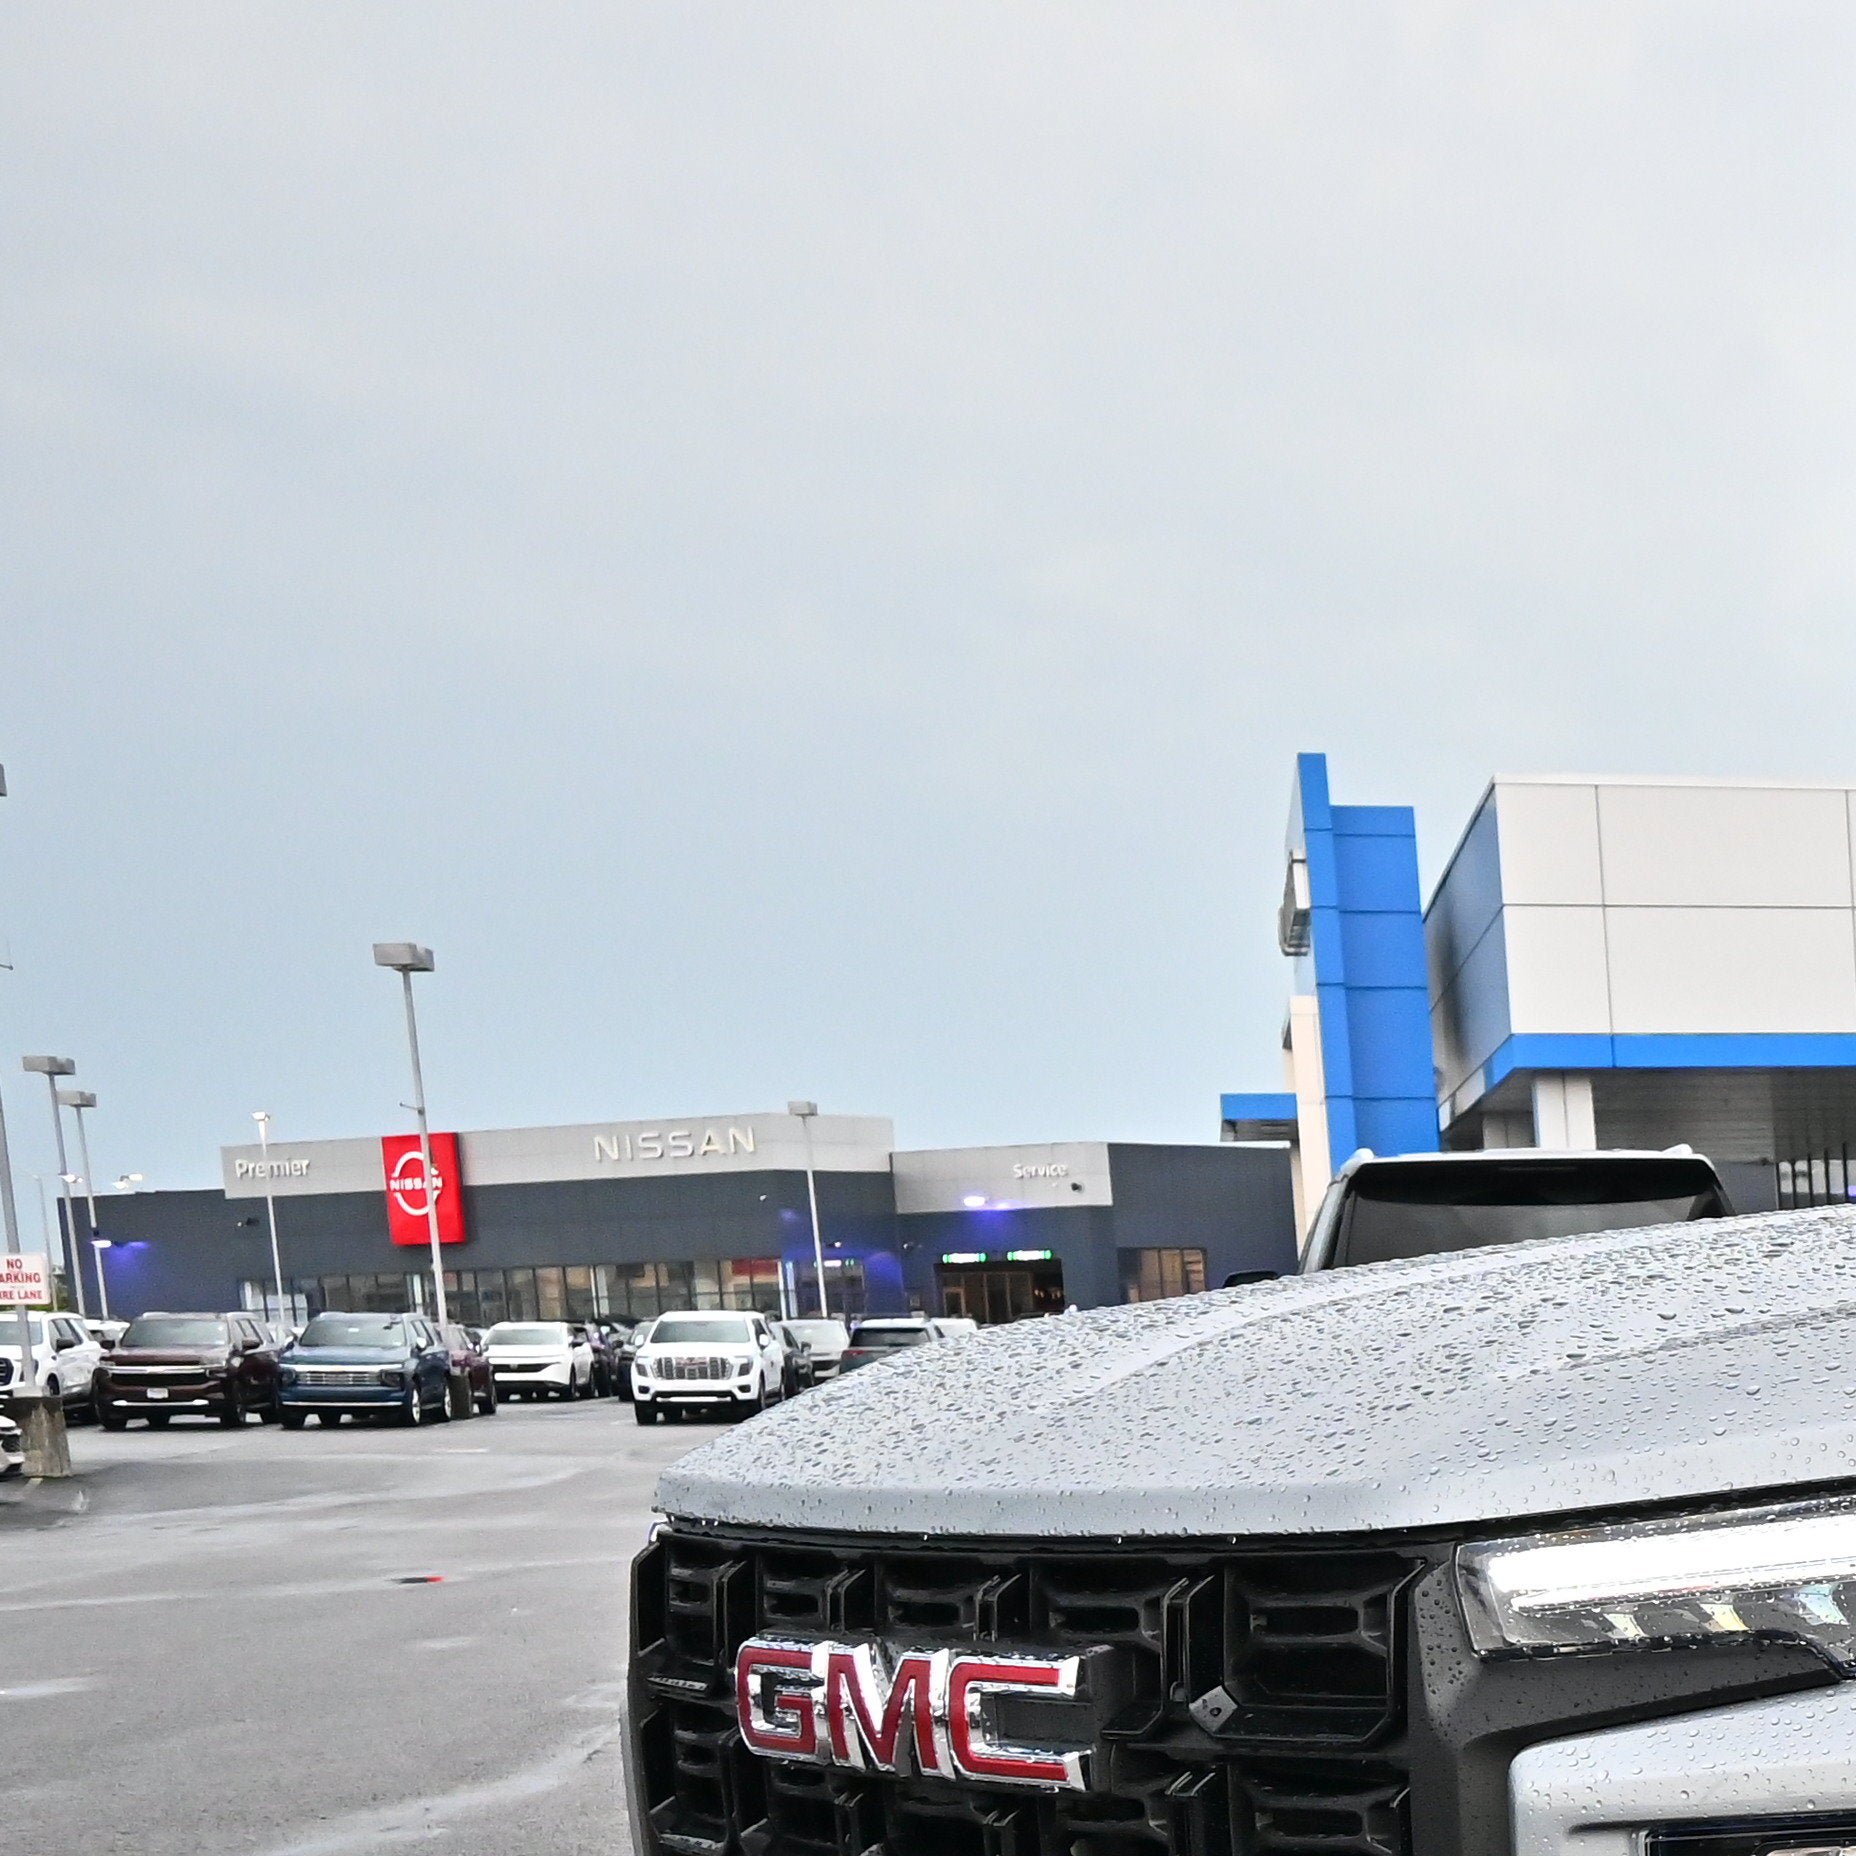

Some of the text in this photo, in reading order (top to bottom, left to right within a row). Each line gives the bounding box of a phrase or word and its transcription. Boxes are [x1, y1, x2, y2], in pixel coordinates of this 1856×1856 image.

[593, 1126, 755, 1162] NISSAN
[235, 1157, 310, 1179] Premier
[1012, 1163, 1069, 1180] Service
[6, 1258, 23, 1270] NO
[18, 1290, 43, 1300] LANE
[735, 1636, 1093, 1792] GMC
